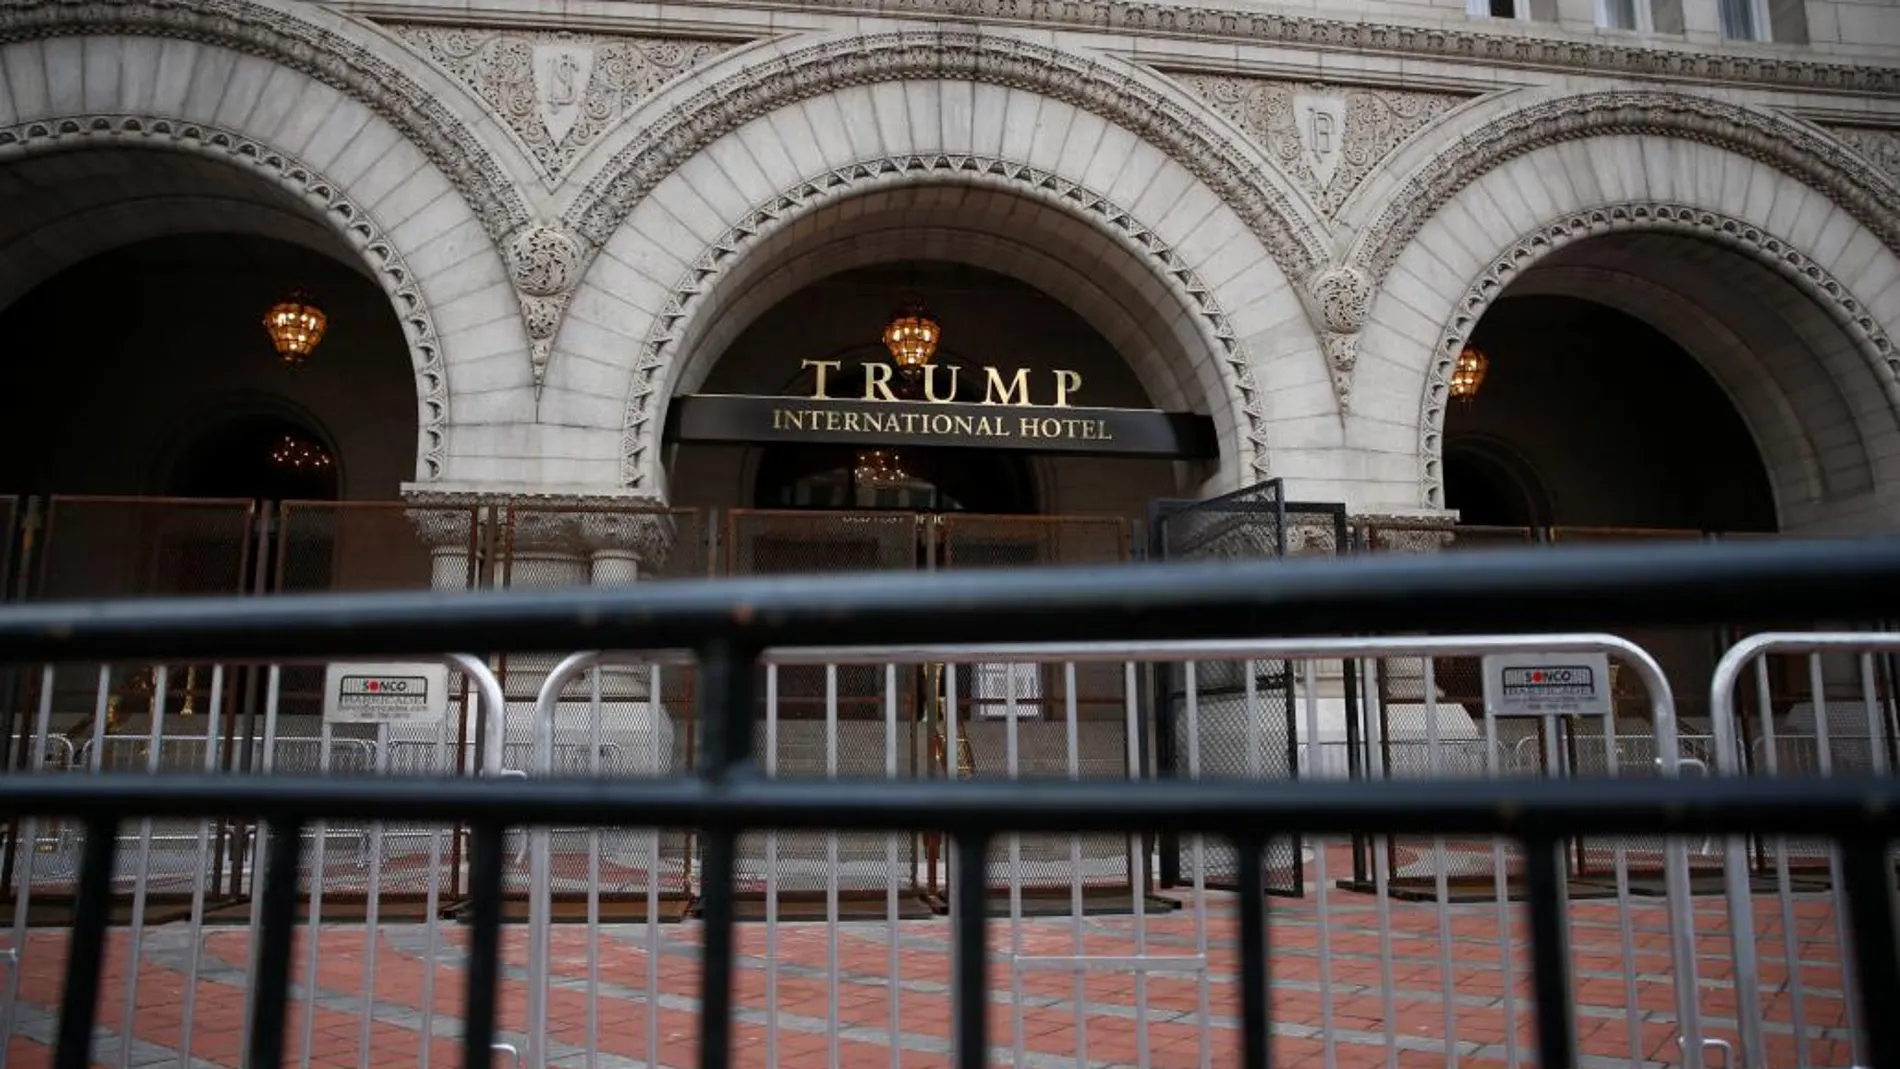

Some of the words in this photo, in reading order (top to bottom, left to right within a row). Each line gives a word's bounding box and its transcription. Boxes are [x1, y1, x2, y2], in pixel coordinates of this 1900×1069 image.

[802, 358, 1082, 408] TRUMP
[772, 408, 1010, 437] INTERNATIONAL
[1020, 417, 1112, 440] HOTEL
[363, 679, 407, 692] SONCO
[1525, 670, 1571, 683] SONCO
